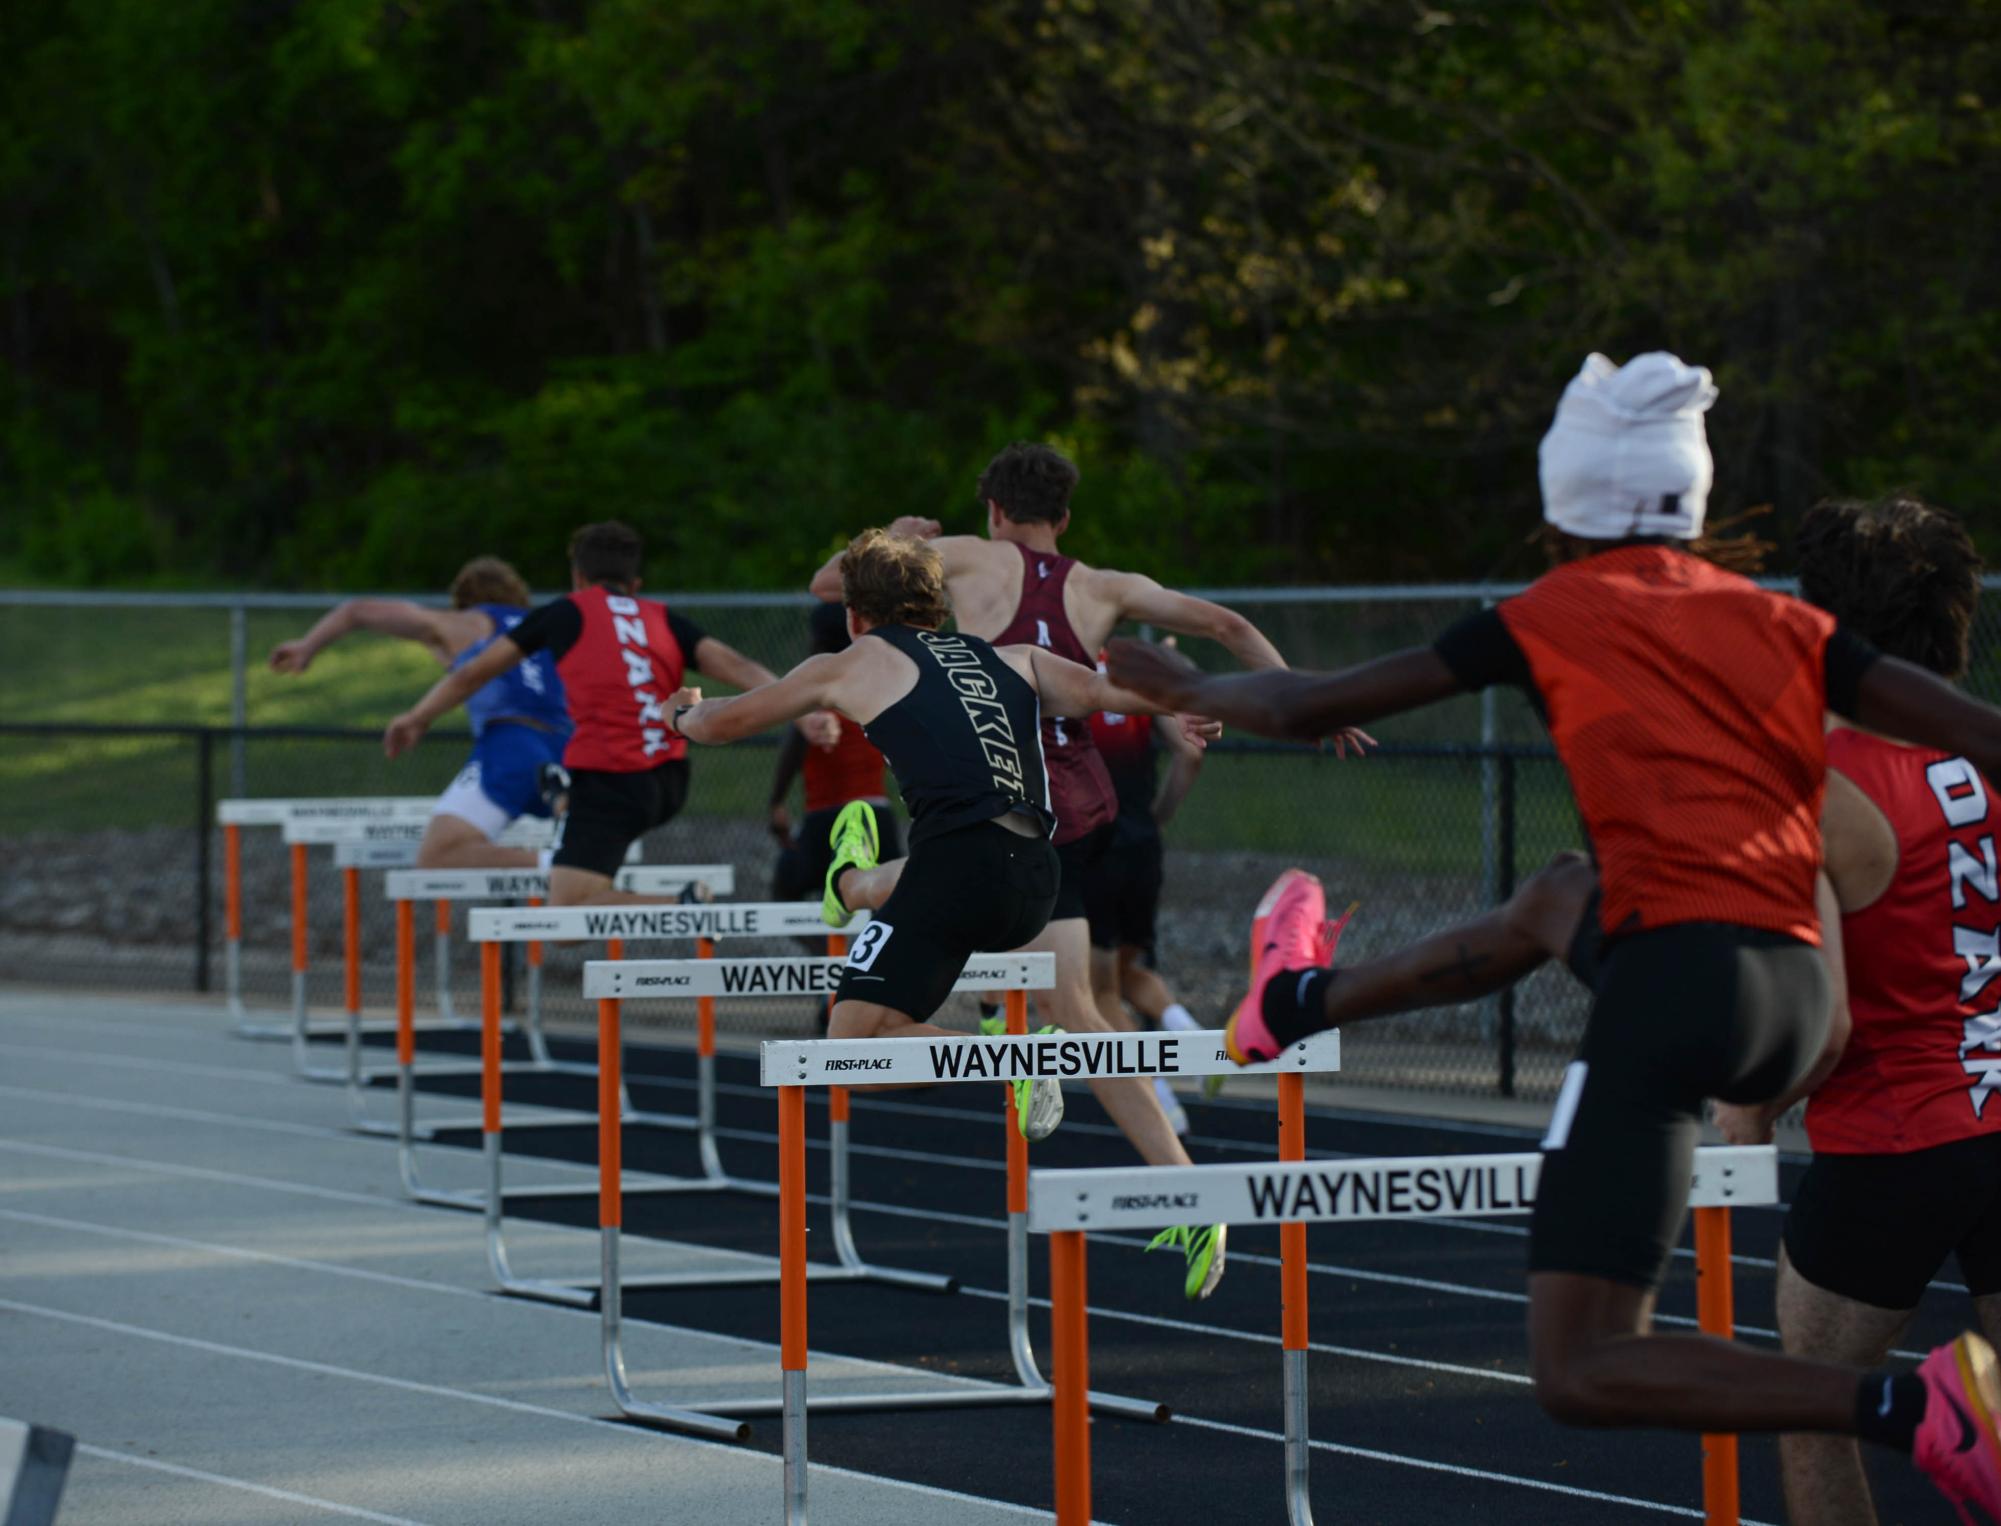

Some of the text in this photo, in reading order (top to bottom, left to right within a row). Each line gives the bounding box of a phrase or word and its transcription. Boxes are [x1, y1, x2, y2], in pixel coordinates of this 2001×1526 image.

[585, 910, 758, 935] WAYNESVILLE
[851, 924, 884, 964] 3
[721, 963, 846, 993] WAYNES
[930, 1039, 1180, 1079] WAYNESVILLE
[1248, 1165, 1536, 1218] WAYNESVILL
